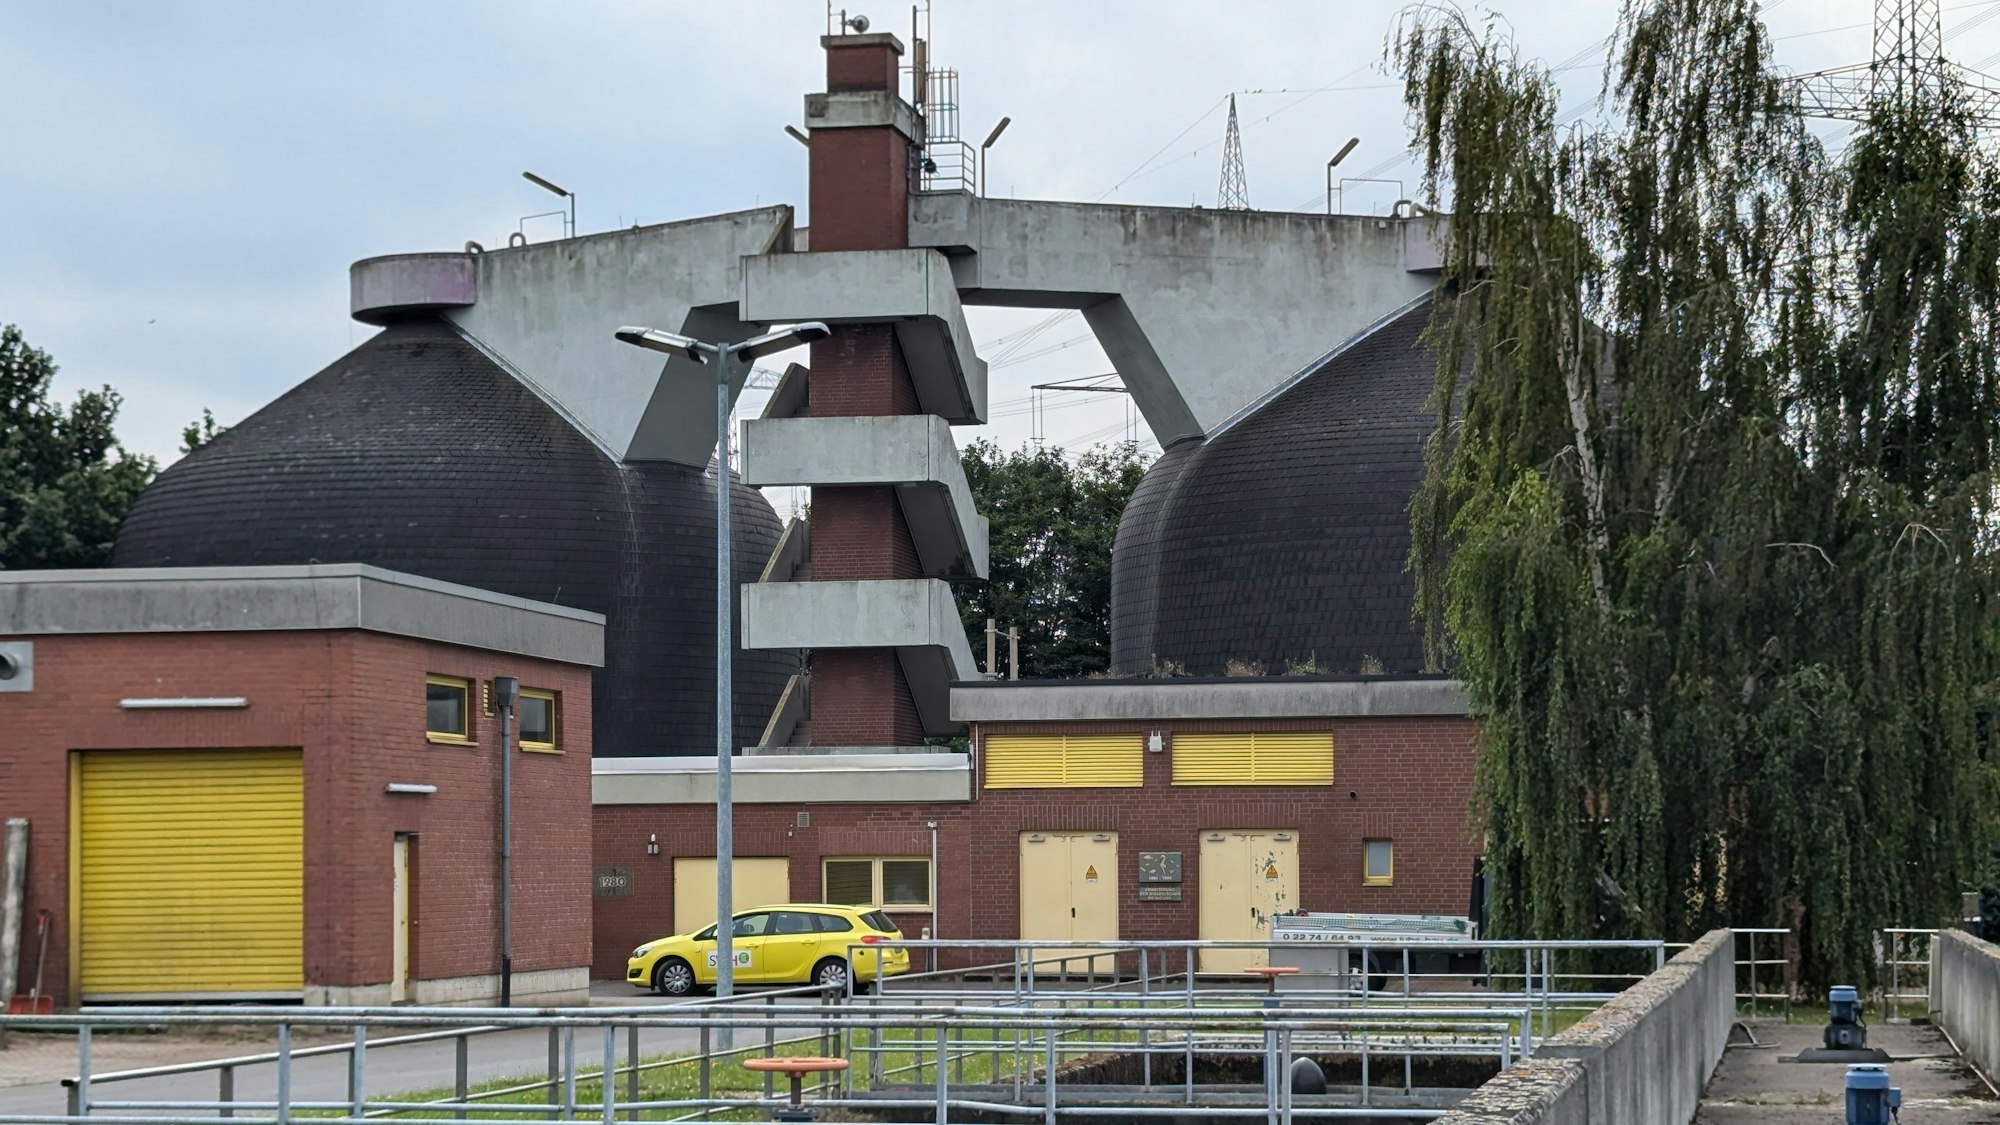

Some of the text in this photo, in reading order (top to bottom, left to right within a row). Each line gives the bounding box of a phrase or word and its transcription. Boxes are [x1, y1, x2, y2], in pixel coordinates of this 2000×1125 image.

[599, 876, 626, 887] 1980
[1292, 933, 1306, 941] 22
[709, 954, 738, 966] SH
